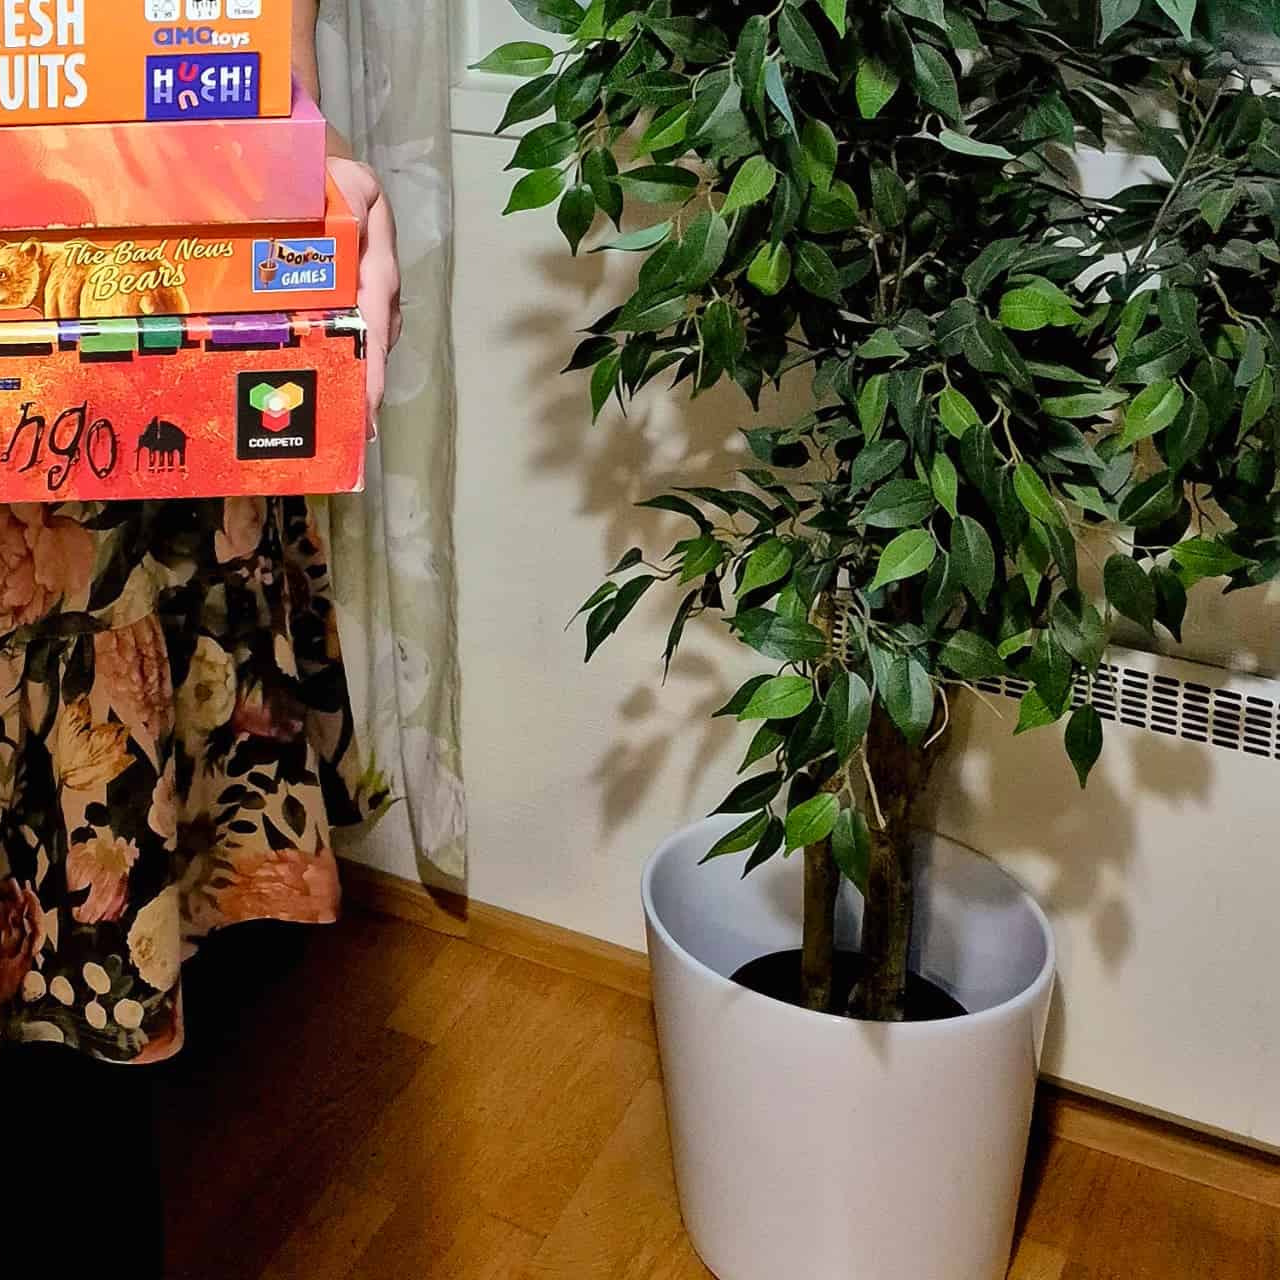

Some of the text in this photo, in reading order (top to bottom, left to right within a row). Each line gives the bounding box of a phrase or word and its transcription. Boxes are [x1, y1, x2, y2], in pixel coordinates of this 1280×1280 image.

[63, 238, 235, 267] The Bad News
[90, 262, 188, 301] Bears
[280, 268, 328, 287] GAMES
[247, 436, 304, 449] COMPETO
